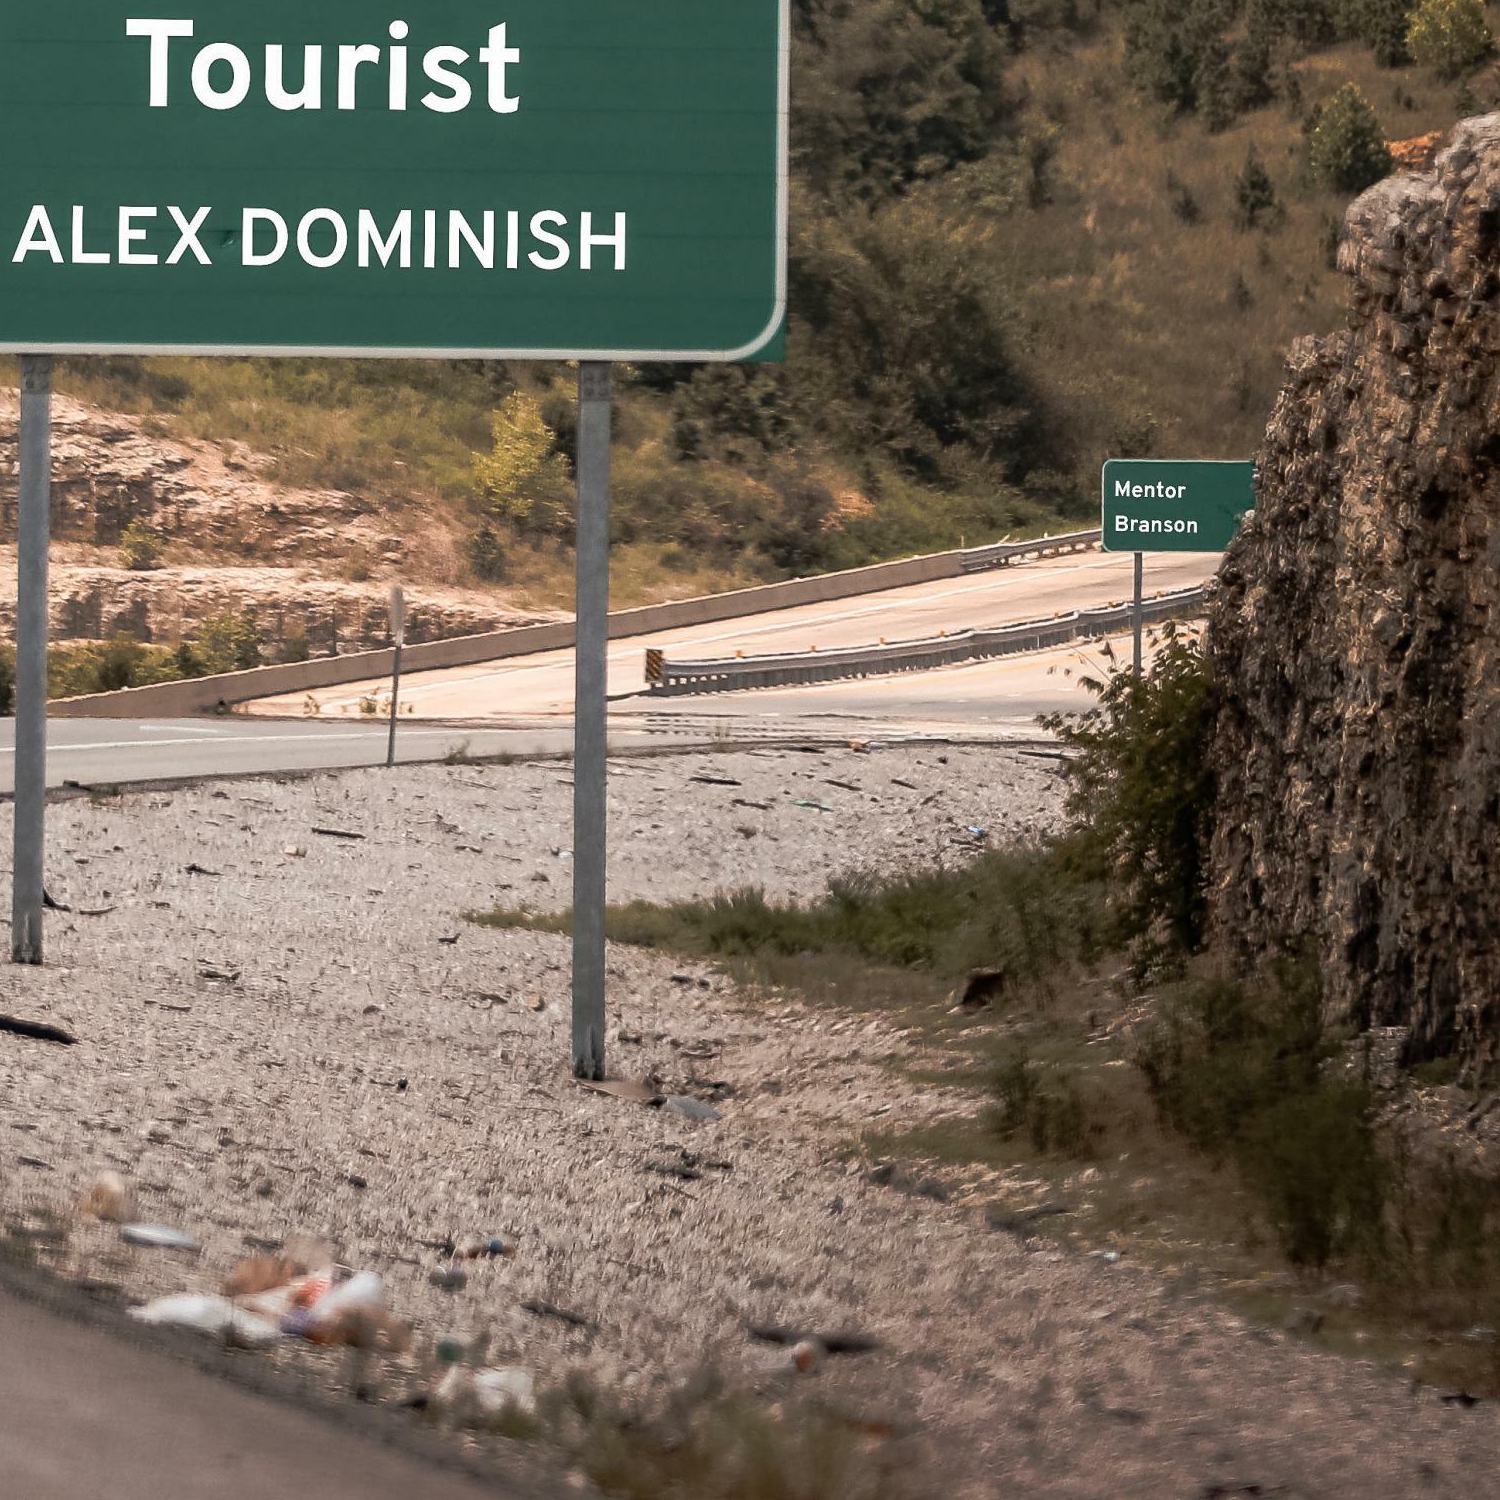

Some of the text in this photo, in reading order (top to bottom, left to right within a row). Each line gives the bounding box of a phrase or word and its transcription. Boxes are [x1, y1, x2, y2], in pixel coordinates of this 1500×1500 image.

[125, 17, 521, 114] Tourist
[11, 204, 627, 270] ALEX DOMINISH
[1114, 480, 1187, 499] Mentor
[1114, 514, 1199, 534] Branson
